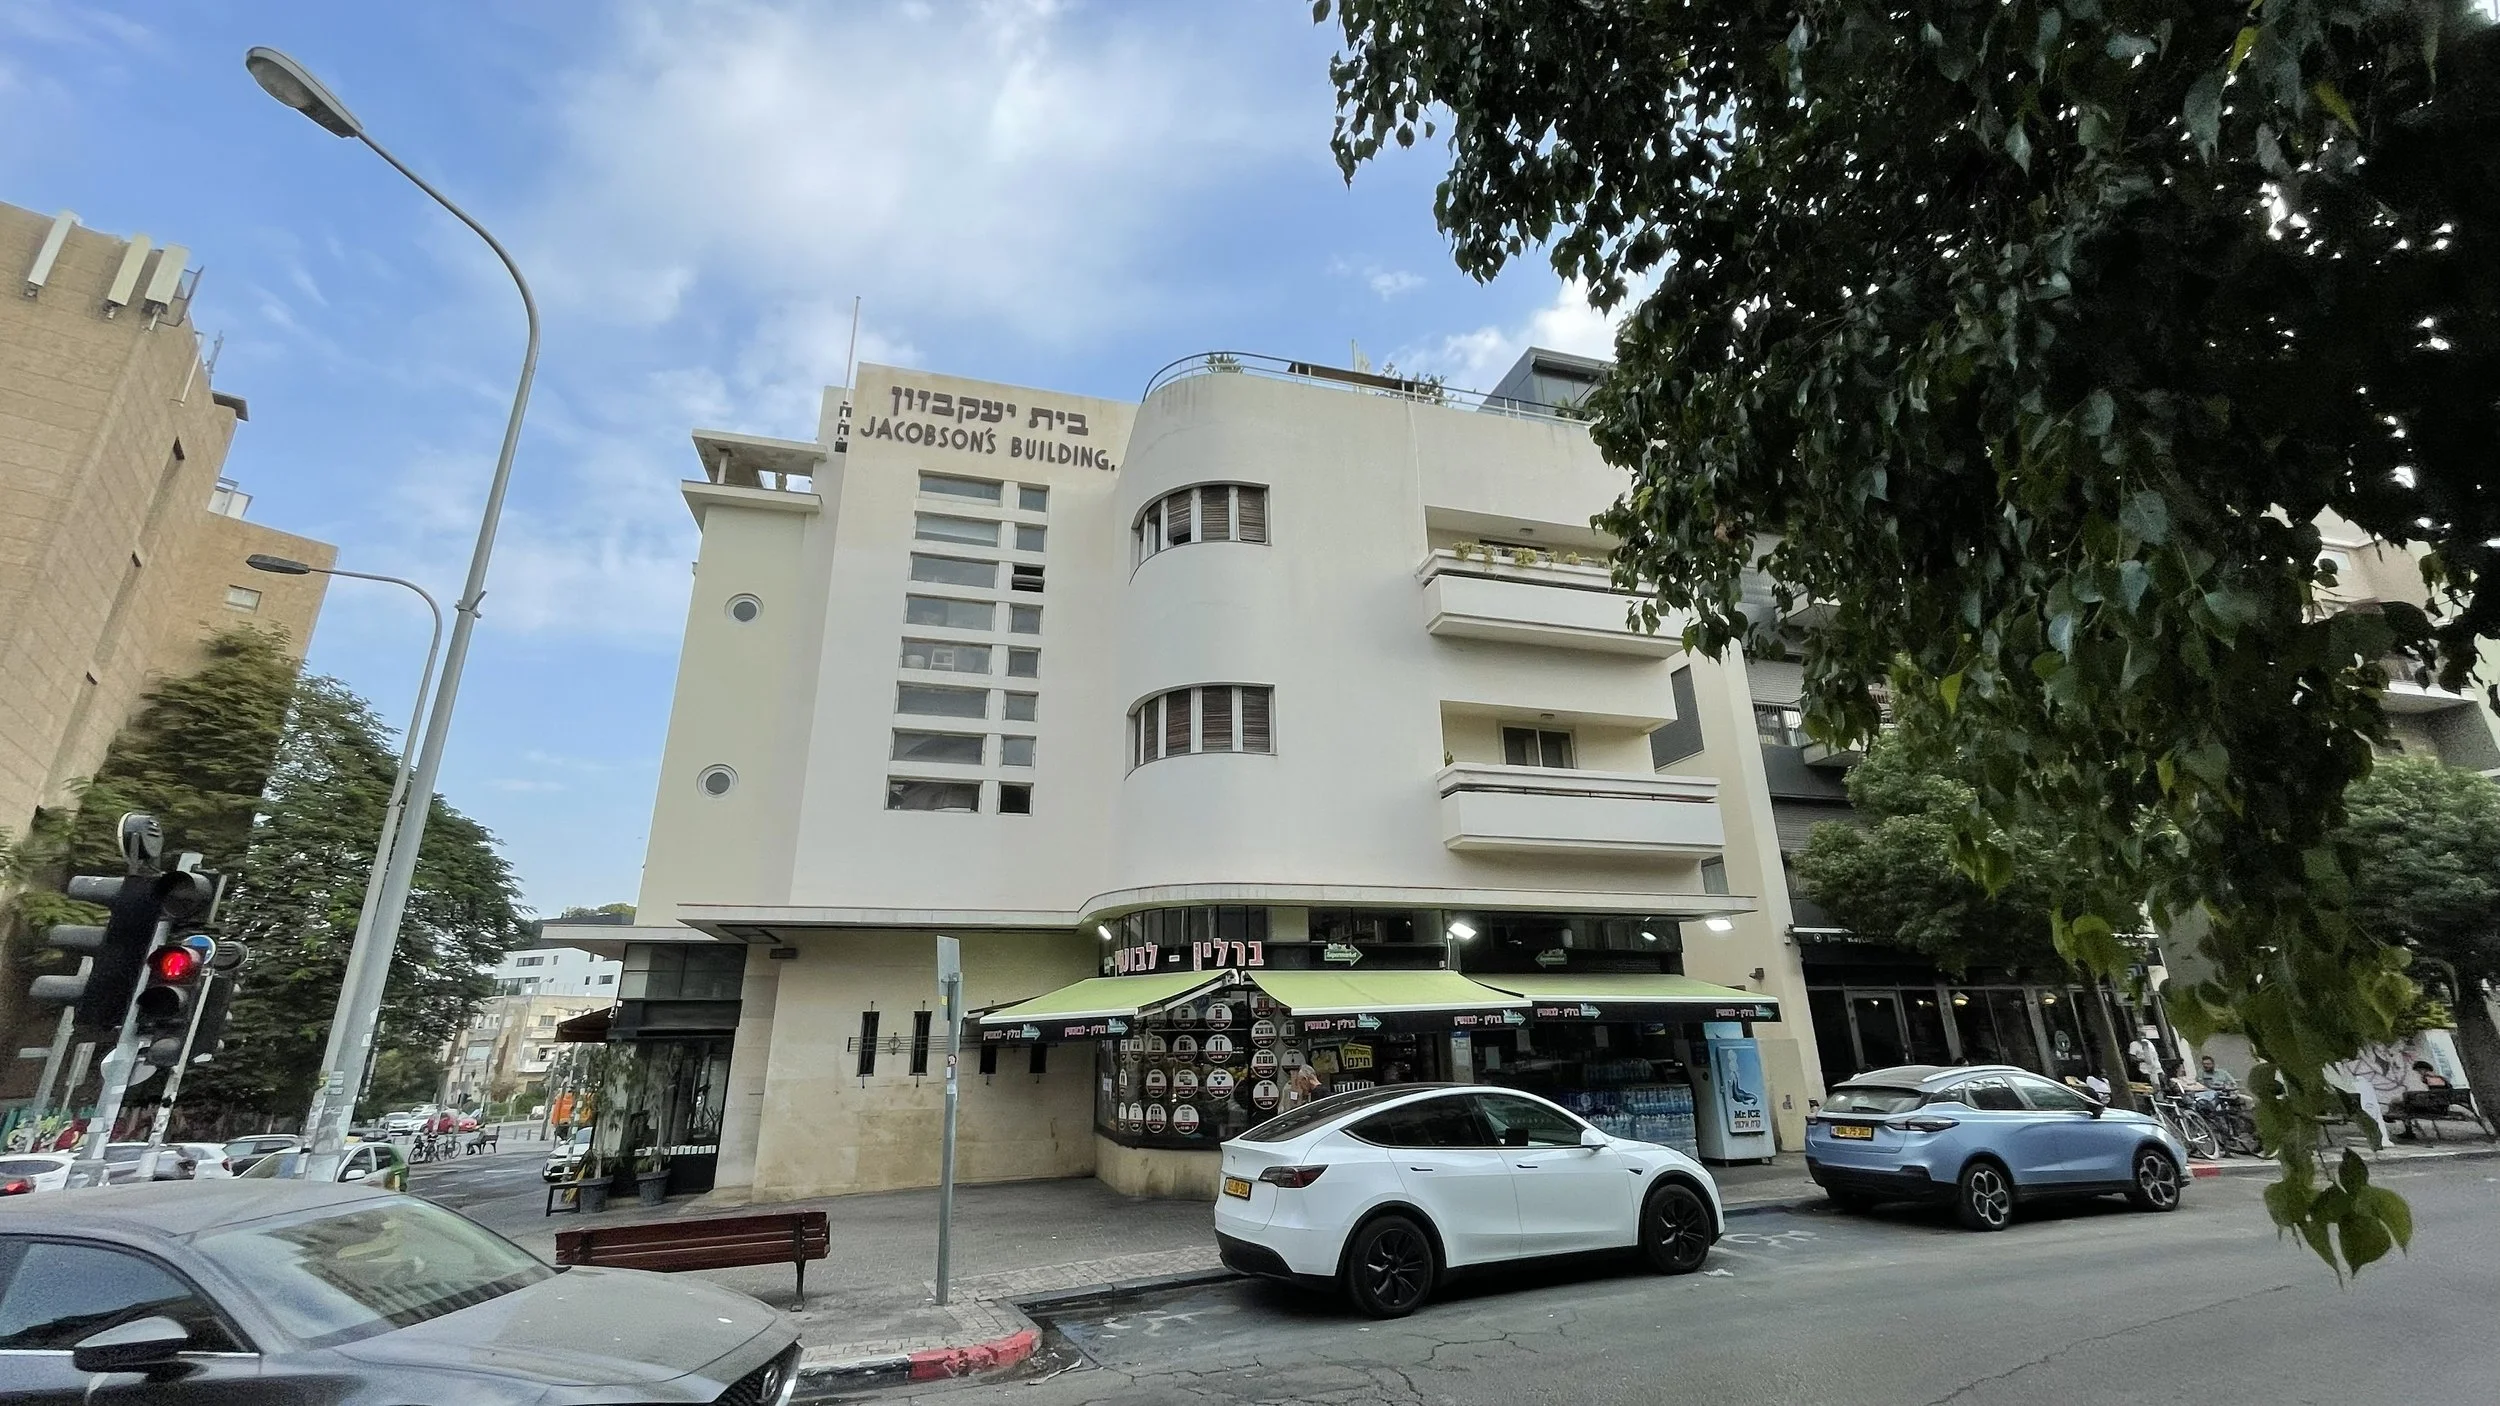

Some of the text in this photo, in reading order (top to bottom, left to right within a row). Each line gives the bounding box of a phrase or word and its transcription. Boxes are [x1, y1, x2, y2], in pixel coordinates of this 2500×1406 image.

[891, 385, 1089, 437] בית יעקבזון
[860, 416, 997, 455] JACOBSON'S
[1193, 937, 1265, 972] ברלין
[1747, 1109, 1760, 1118] ICE
